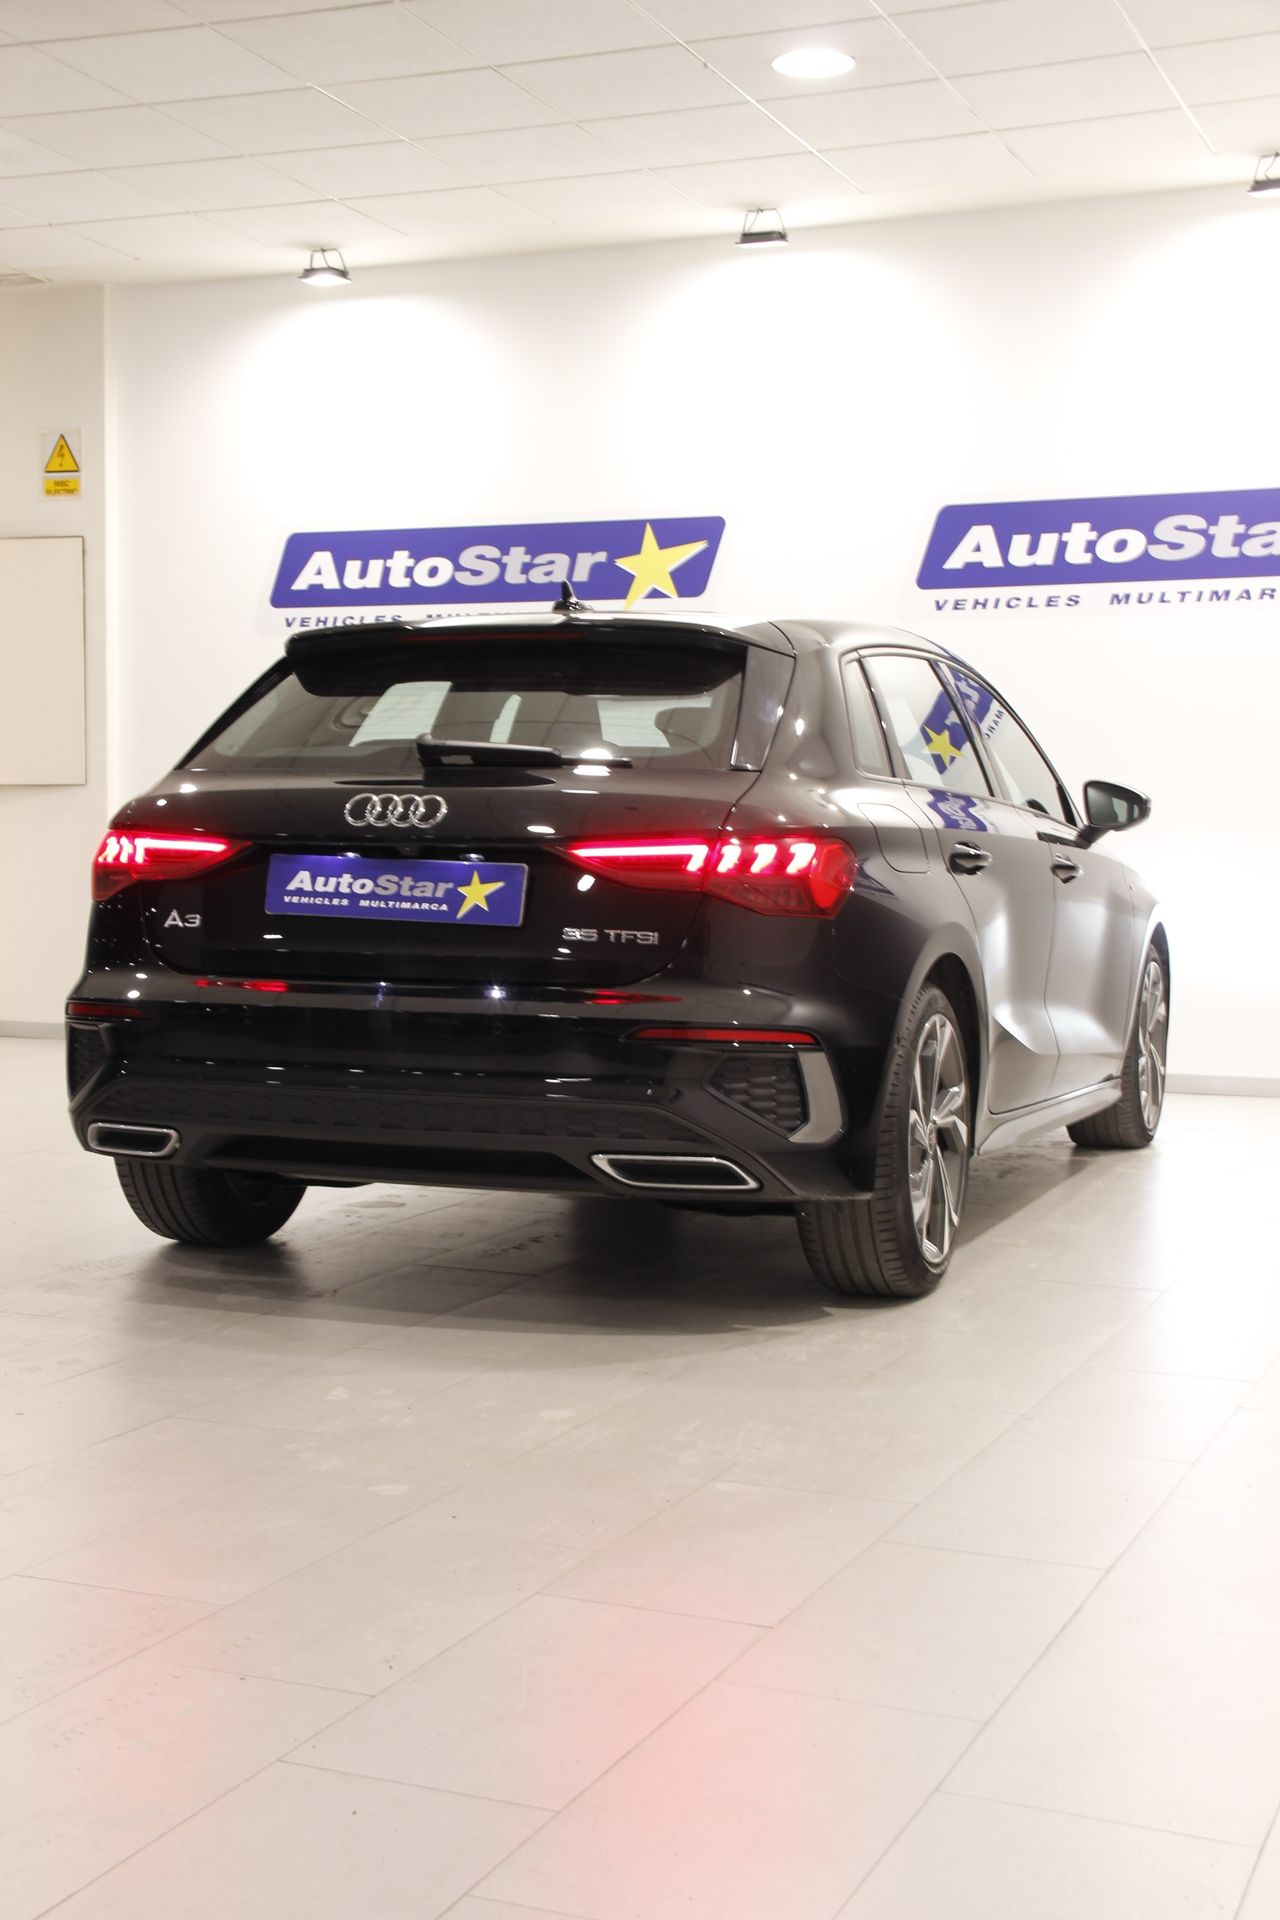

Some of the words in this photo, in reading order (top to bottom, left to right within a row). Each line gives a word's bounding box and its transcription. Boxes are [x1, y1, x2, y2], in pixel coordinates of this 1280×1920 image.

[942, 513, 1280, 570] AutoSta
[291, 544, 608, 591] AutoStar
[934, 594, 1081, 611] VEHICLES
[1109, 587, 1277, 606] MULTIMAR
[286, 869, 454, 898] AutoStar
[284, 895, 350, 906] VEHICLES
[359, 899, 449, 911] MULTIMARCA
[163, 908, 202, 928] A3
[562, 927, 599, 942] 35
[604, 929, 660, 945] TFSI
